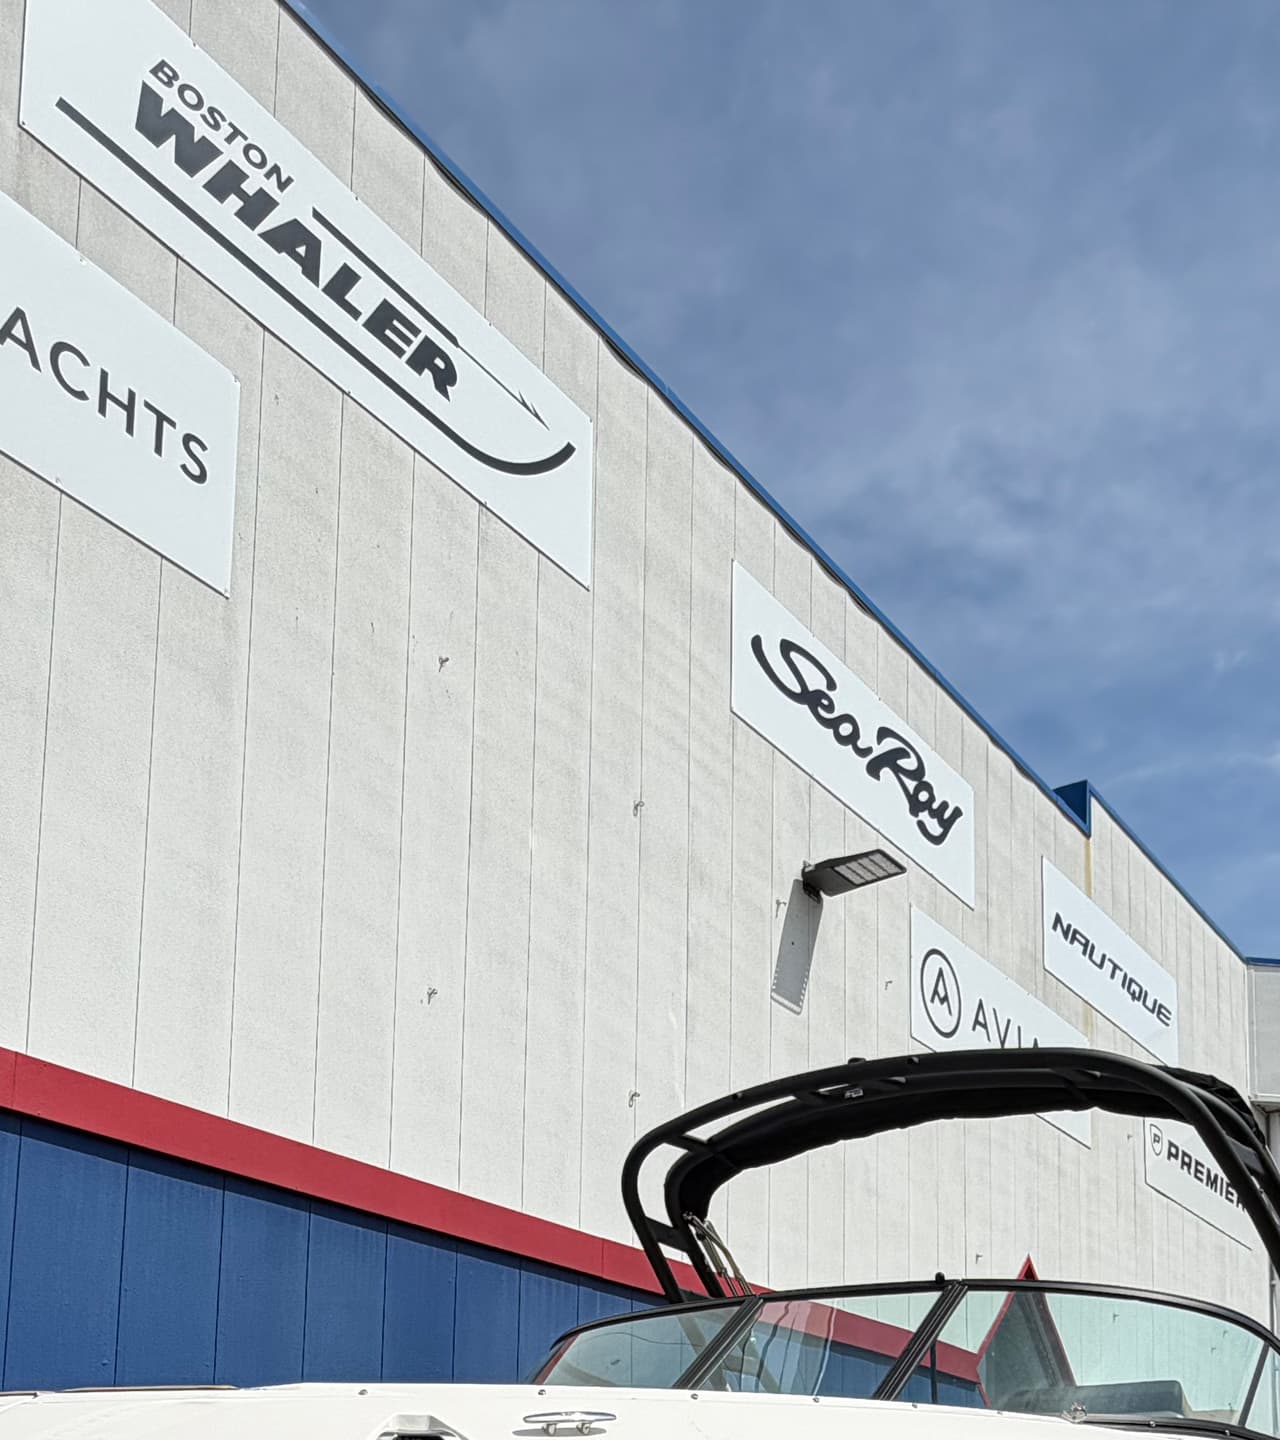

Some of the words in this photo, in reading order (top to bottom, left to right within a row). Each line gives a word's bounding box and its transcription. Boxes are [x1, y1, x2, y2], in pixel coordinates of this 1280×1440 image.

[148, 59, 294, 194] BOSTON
[134, 80, 458, 402] WHALER
[750, 634, 873, 759] Sea
[866, 726, 964, 846] Ray
[971, 998, 1039, 1049] AVI
[1051, 912, 1172, 1027] NAUTIQUE
